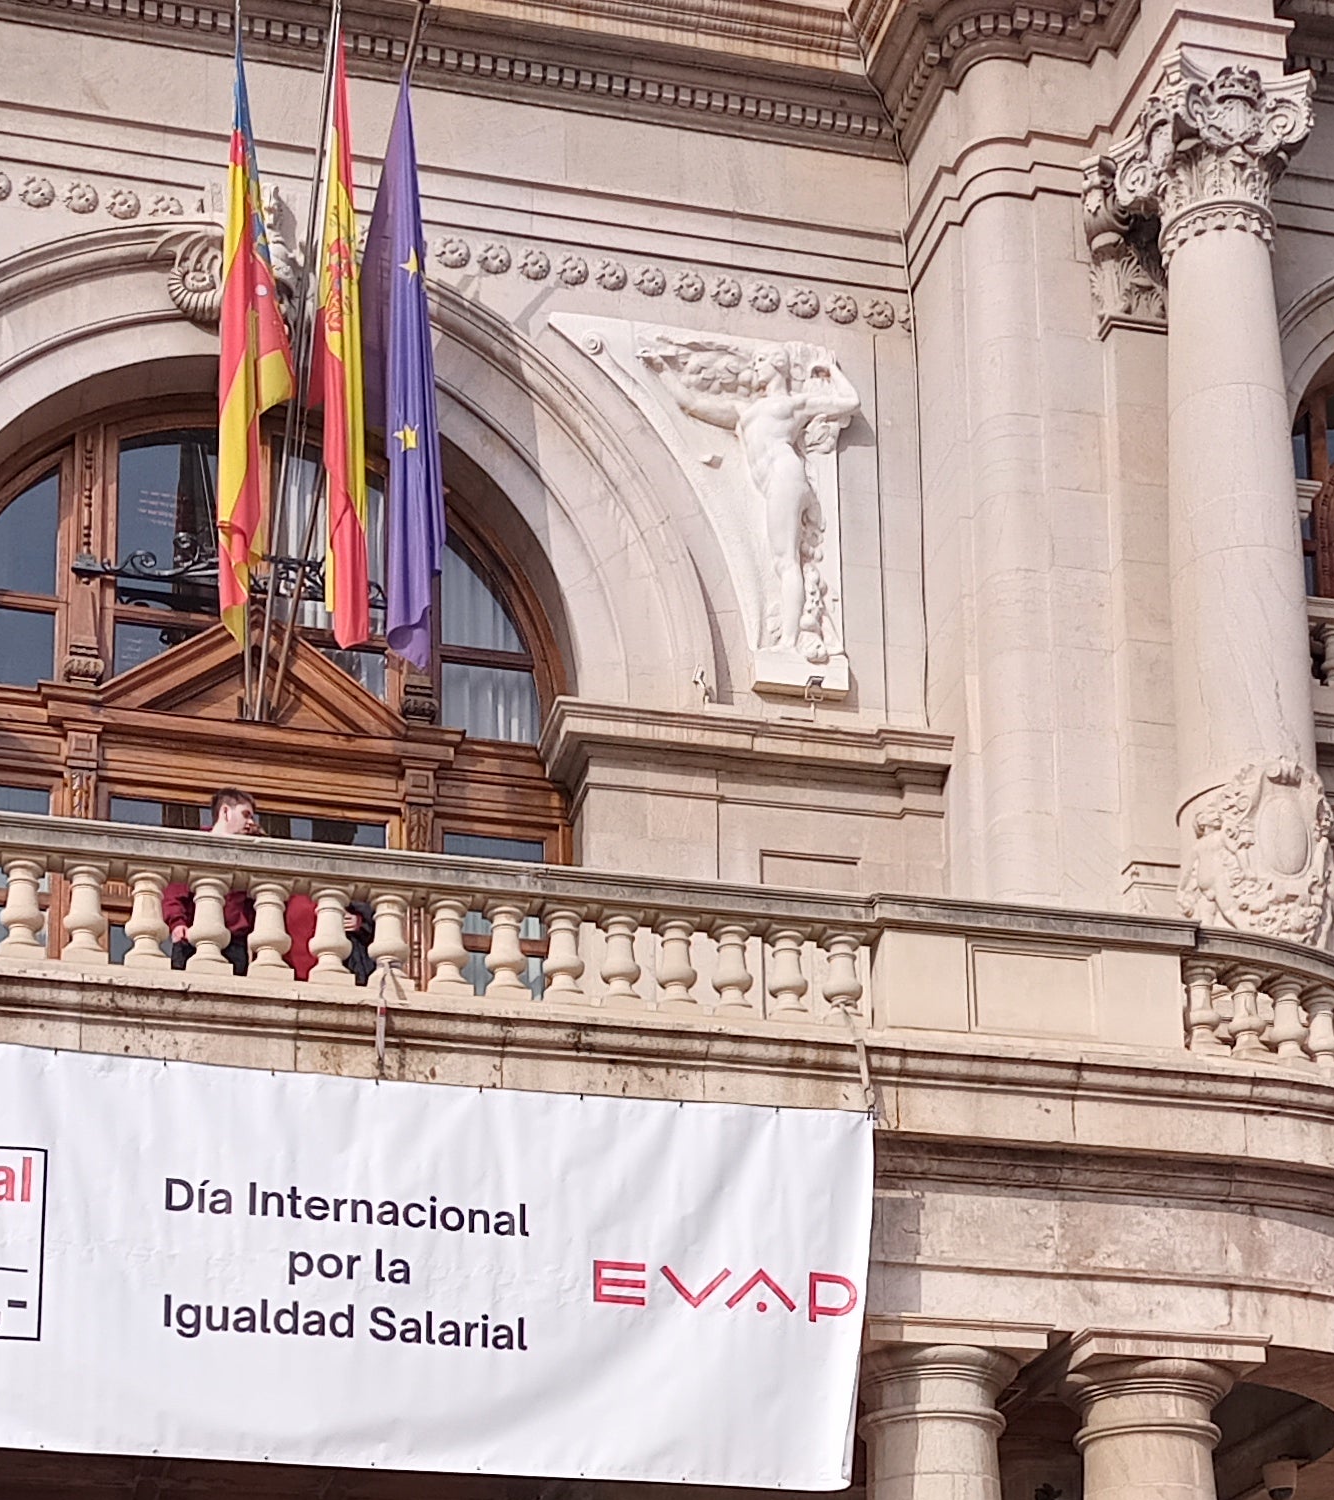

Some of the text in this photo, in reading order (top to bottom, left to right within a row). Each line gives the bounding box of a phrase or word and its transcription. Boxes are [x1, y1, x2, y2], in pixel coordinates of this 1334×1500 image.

[164, 1177, 530, 1237] Día Internacional
[288, 1248, 411, 1285] por la
[592, 1259, 858, 1323] EVAP
[163, 1293, 529, 1351] Igualdad Salarial
